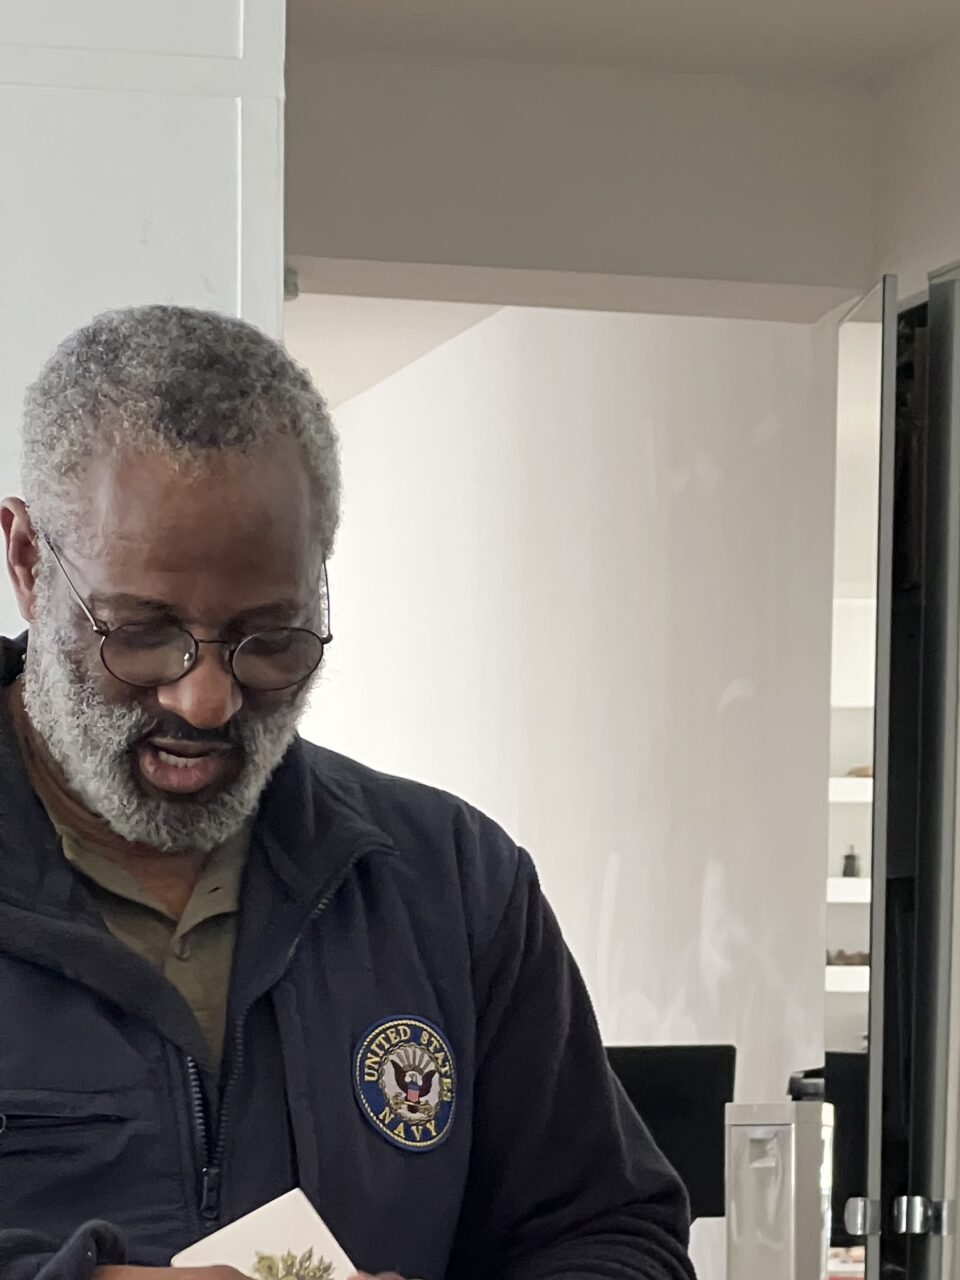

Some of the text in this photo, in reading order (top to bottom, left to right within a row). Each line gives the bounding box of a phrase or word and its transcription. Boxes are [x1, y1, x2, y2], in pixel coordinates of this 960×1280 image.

[365, 1027, 452, 1101] UNITED STATES
[381, 1108, 437, 1140] NAVY
